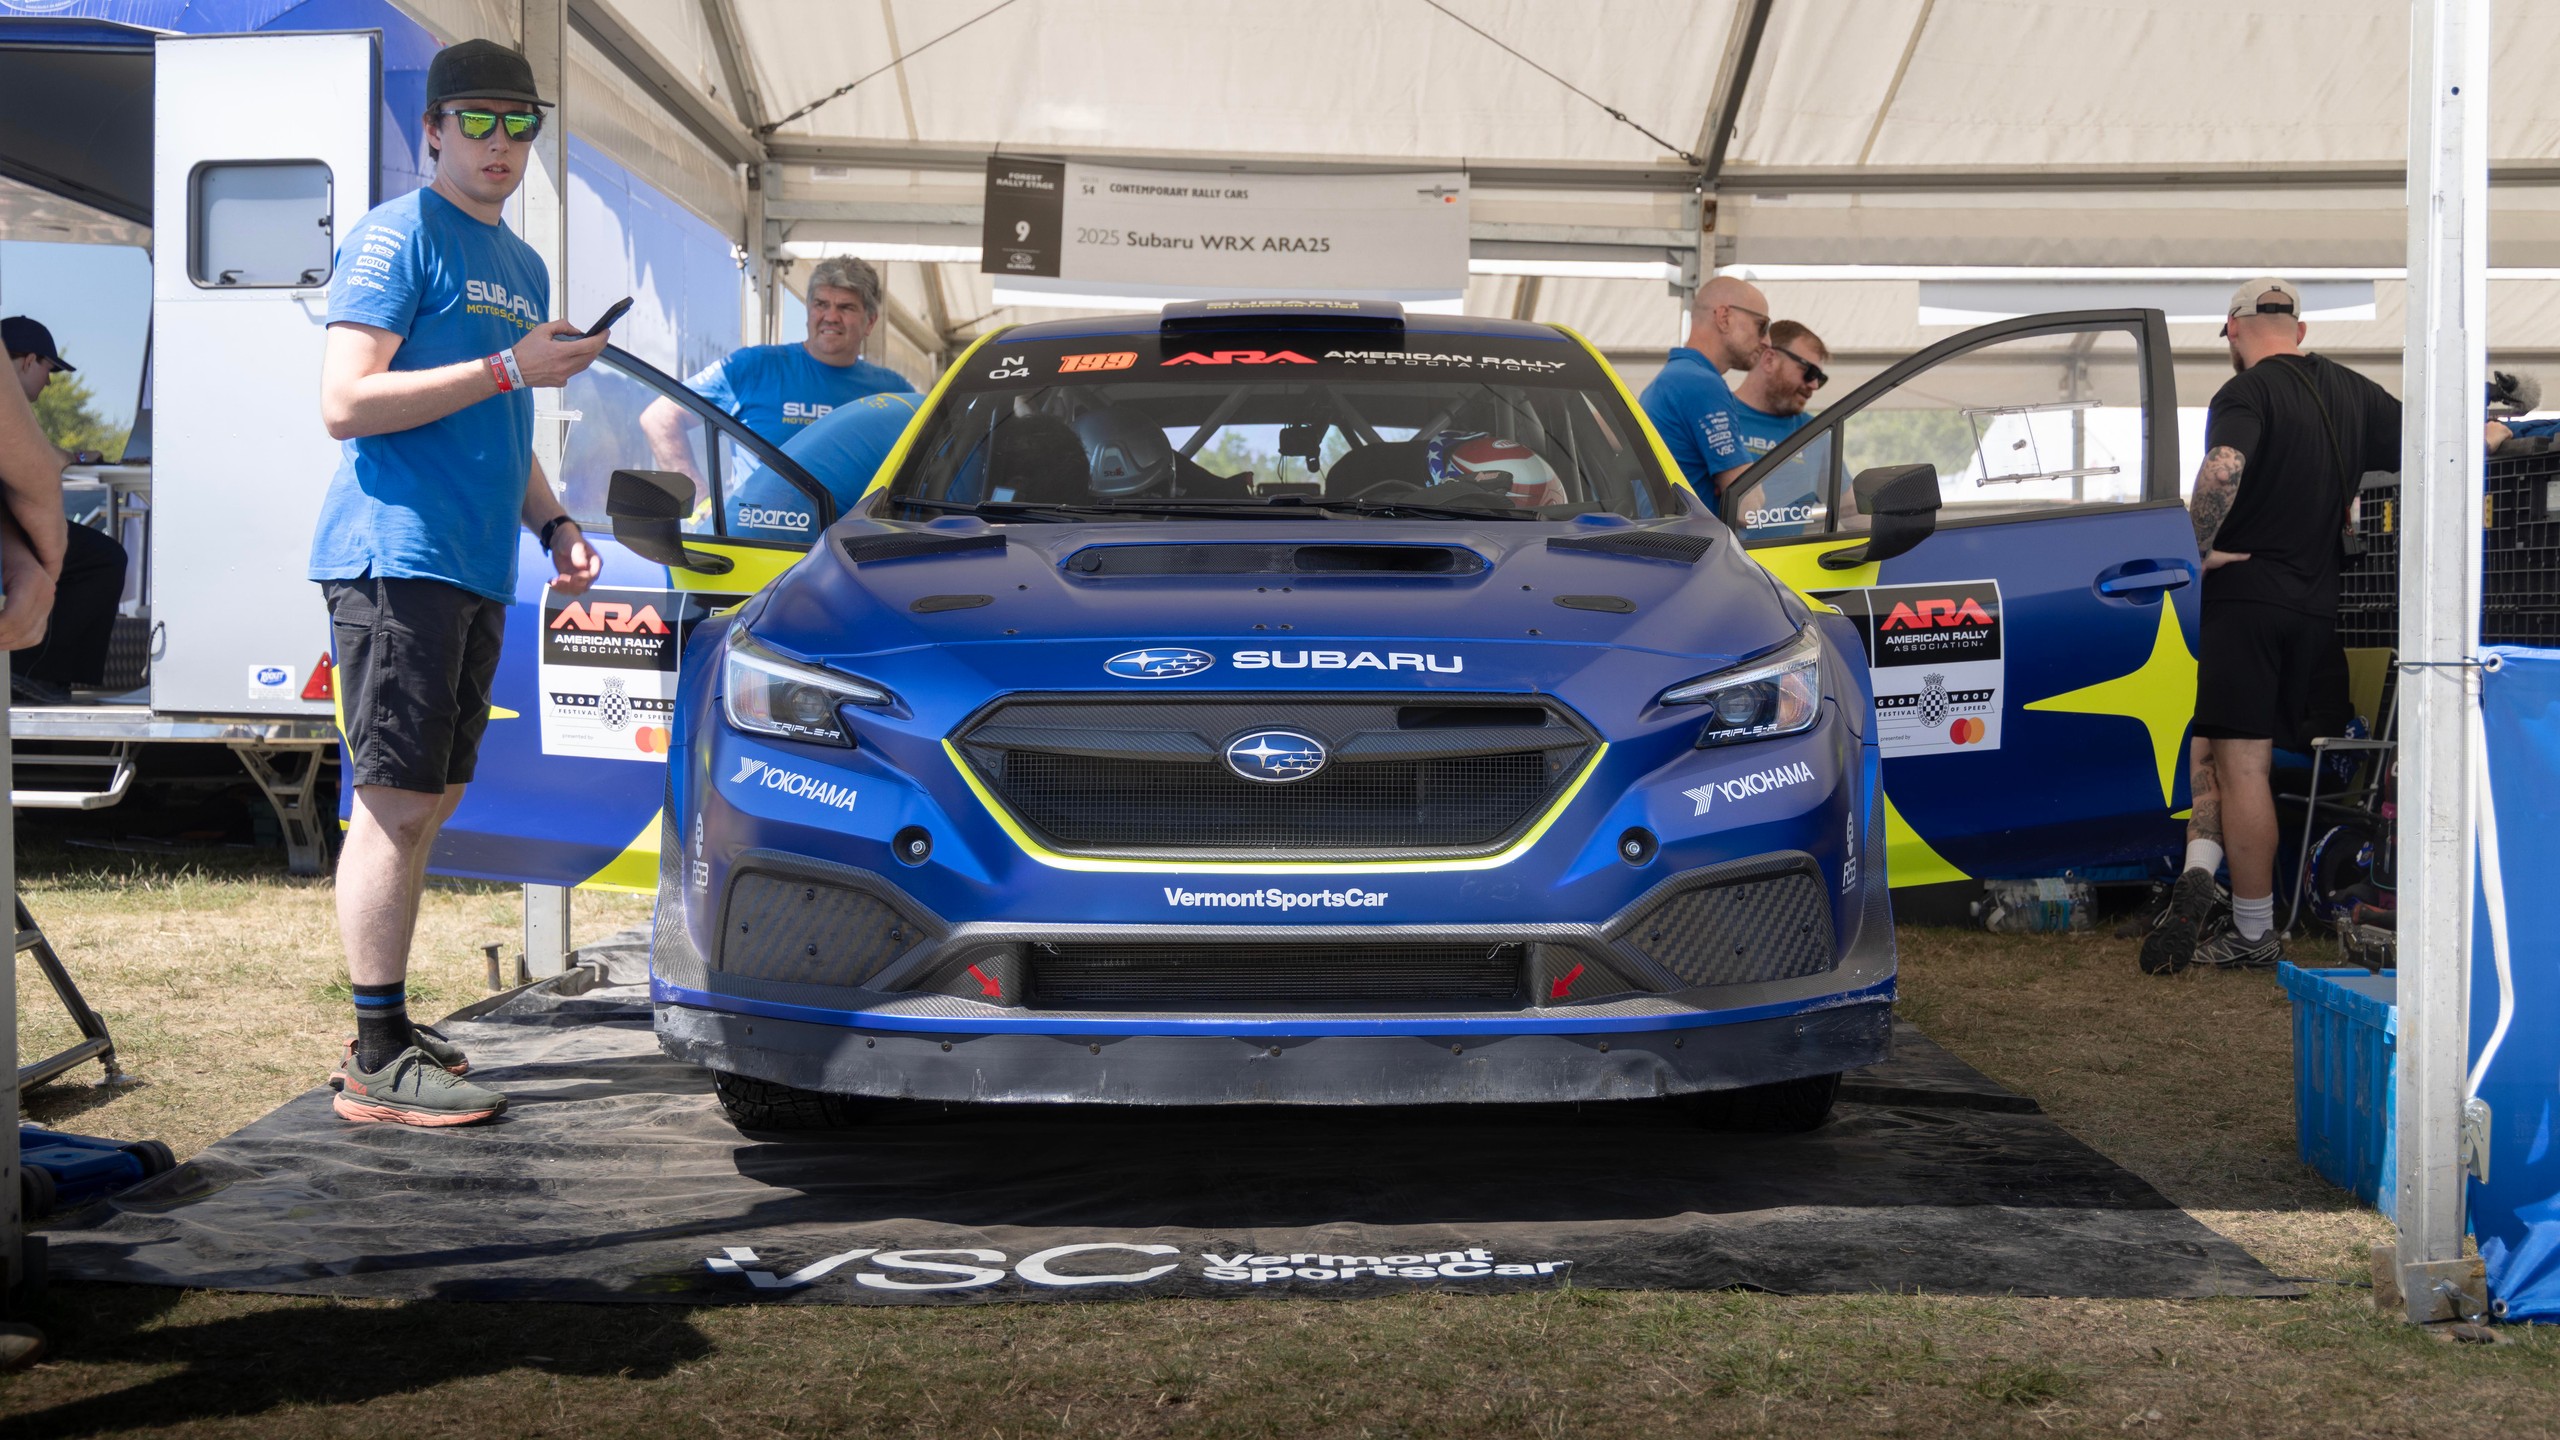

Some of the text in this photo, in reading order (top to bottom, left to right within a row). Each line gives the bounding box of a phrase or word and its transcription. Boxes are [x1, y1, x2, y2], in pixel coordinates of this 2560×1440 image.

[996, 179, 1054, 190] RALLY STAGE
[1009, 172, 1043, 181] FOREST
[1109, 183, 1248, 199] CONTEMPORARY RALLY CARS
[1015, 220, 1031, 242] 9
[1076, 227, 1330, 252] 2025 Subaru WRX ARA25
[360, 258, 388, 270] MOTUL
[346, 276, 369, 287] VSC
[1001, 356, 1025, 366] N
[1057, 351, 1139, 373] 199
[1160, 350, 1318, 366] ARA
[1324, 350, 1566, 370] AMERICAN RALLY
[991, 367, 1030, 379] 04
[738, 508, 810, 528] sparco
[1744, 505, 1812, 529] sparco
[550, 601, 671, 634] ARA
[1880, 597, 1994, 630] ARA
[555, 634, 664, 648] AMERICAN RALLY
[1885, 630, 1989, 645] AMERICAN RALLY
[1232, 650, 1463, 674] SUBARU
[556, 695, 675, 710] GOOD WOOD
[1878, 692, 1990, 707] GOOD WOOD
[558, 708, 598, 716] FESTIVAL
[1879, 710, 1917, 718] FESTIVAL
[1963, 704, 1987, 712] SPEED
[770, 721, 840, 739] TRIPLE-R
[1708, 723, 1778, 740] TRIPLE-R
[759, 765, 858, 812] YOKOHAMA
[1715, 761, 1816, 803] YOKOHAMA
[1163, 887, 1389, 912] VermontSportsCar
[705, 1243, 1181, 1290] VSC
[1201, 1248, 1494, 1267] Vermont
[1203, 1261, 1566, 1283] SportsCar
